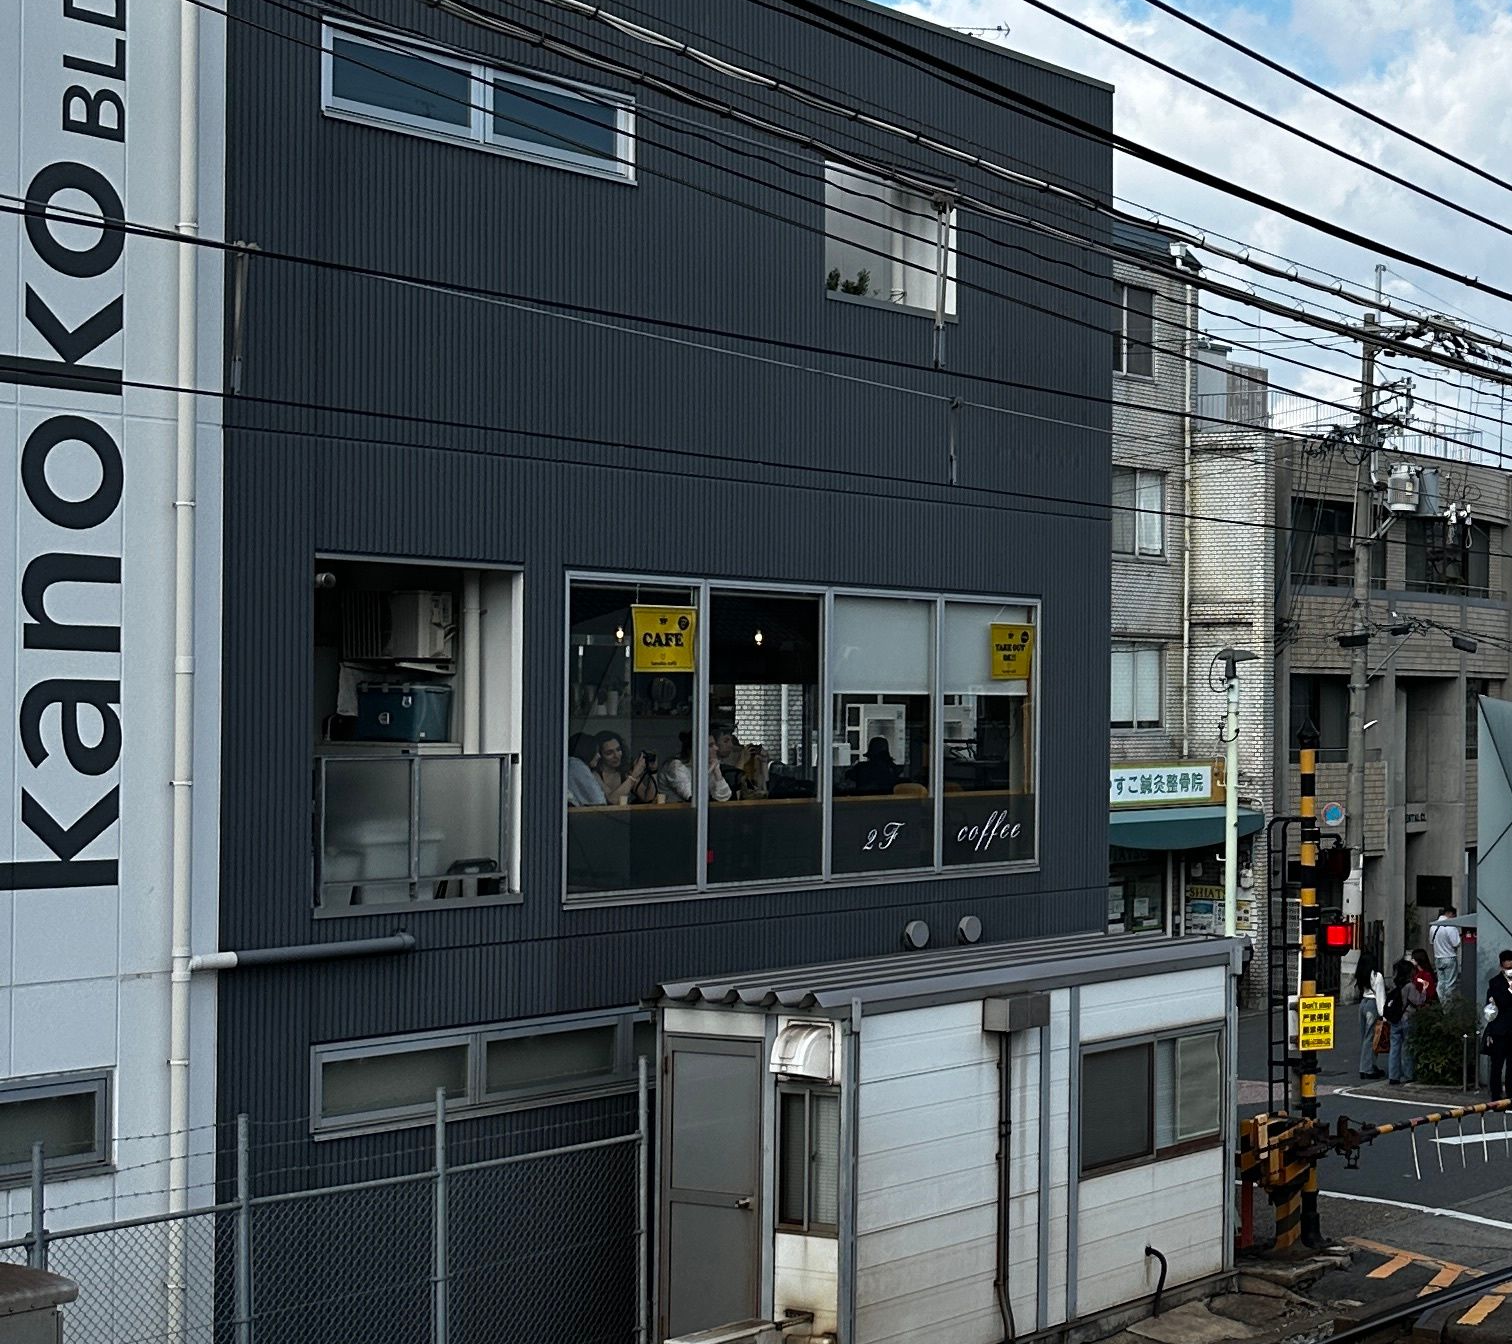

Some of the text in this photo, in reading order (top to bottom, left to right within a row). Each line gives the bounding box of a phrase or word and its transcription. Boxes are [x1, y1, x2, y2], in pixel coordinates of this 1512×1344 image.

[0, 161, 125, 891] kanoko
[643, 632, 684, 647] CAFE
[1110, 772, 1204, 795] すこ鍼灸整骨院
[863, 809, 1021, 851] 2F coffee
